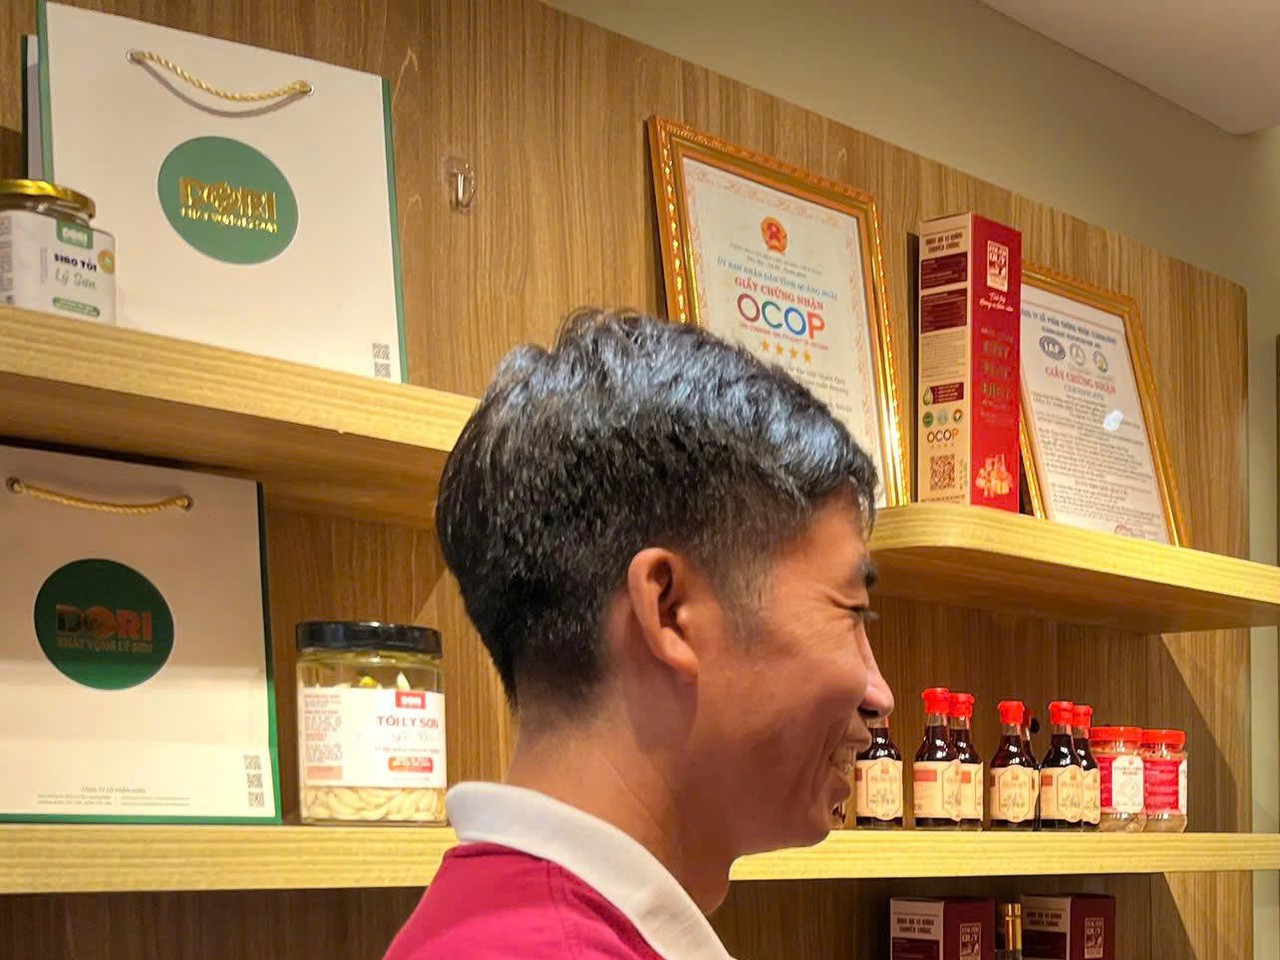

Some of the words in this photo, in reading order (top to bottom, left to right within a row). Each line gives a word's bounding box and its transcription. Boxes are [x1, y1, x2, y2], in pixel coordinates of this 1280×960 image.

[179, 176, 276, 221] DORI
[737, 293, 826, 340] OCOP
[927, 428, 959, 444] OCOP
[56, 603, 153, 641] DORI
